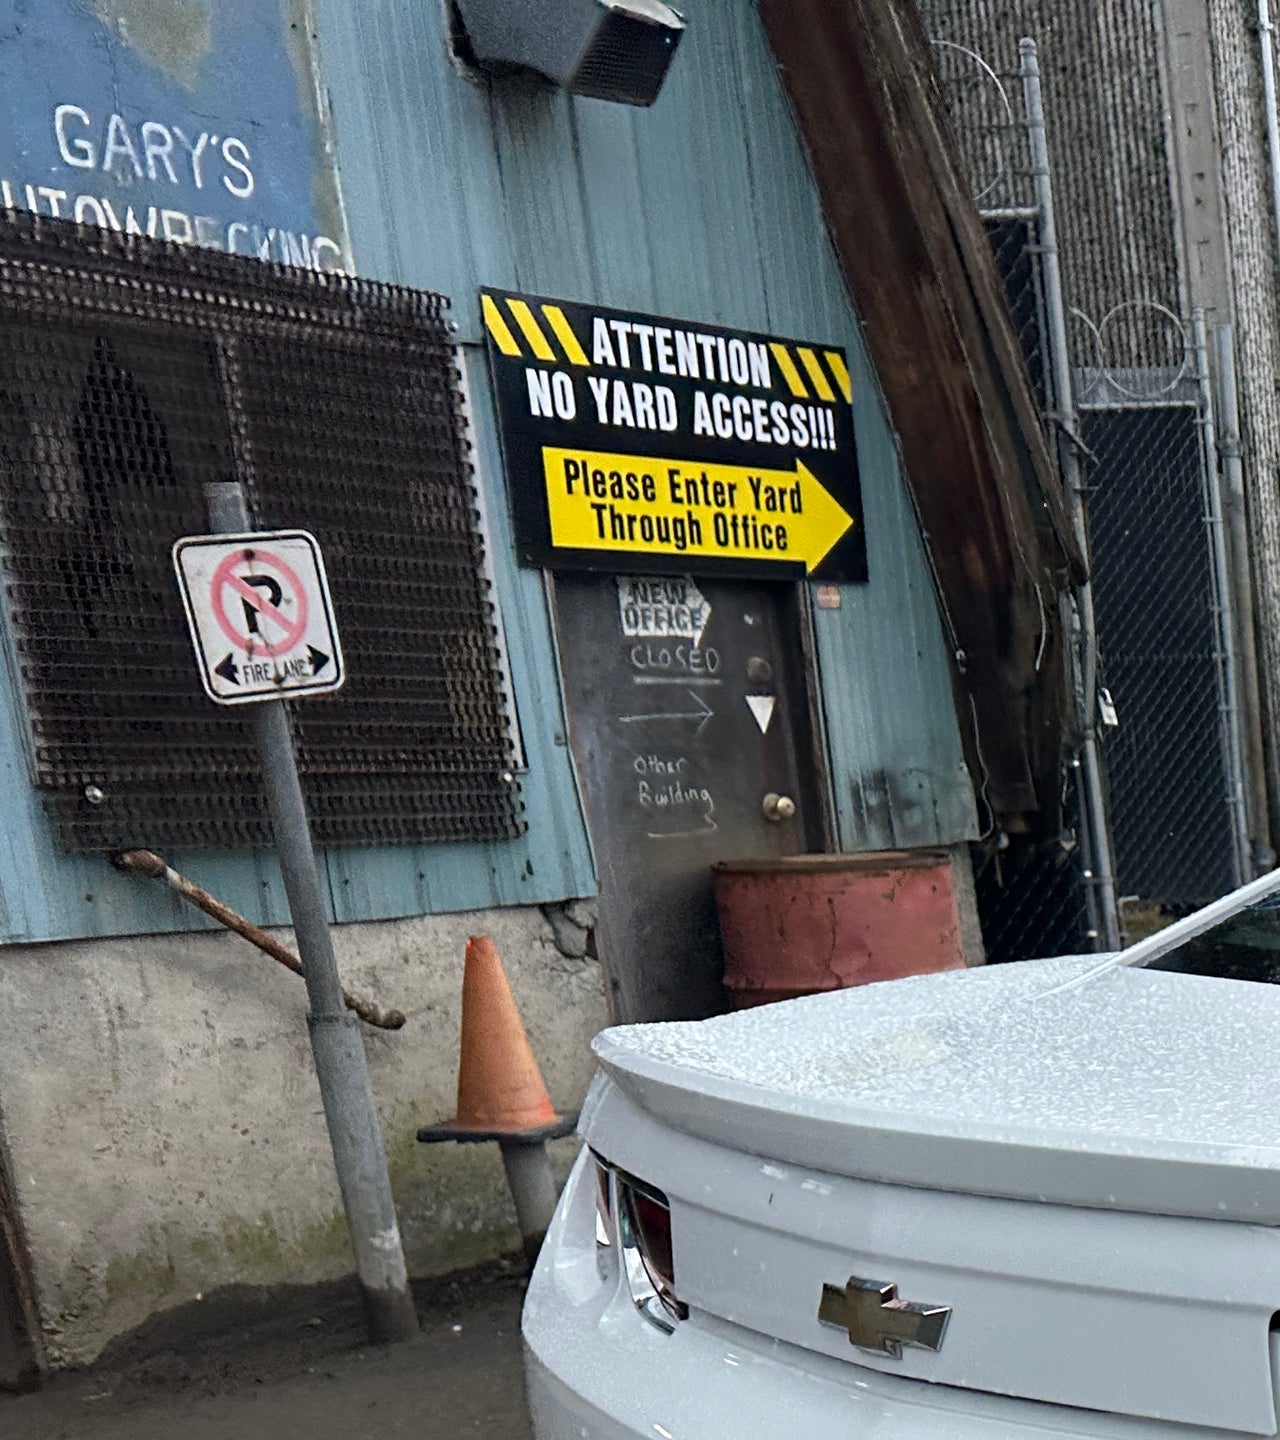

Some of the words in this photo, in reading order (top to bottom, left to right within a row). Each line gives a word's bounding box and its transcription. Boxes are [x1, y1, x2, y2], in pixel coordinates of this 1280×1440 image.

[55, 103, 254, 199] GARY'S
[592, 317, 773, 389] ATTENTION
[525, 368, 576, 421] NO
[588, 377, 678, 432] YARD
[693, 391, 837, 450] ACCESS!!!
[563, 459, 656, 501] Please
[668, 469, 737, 509] Enter
[747, 477, 803, 515] Yard
[591, 503, 705, 550] Through
[714, 513, 788, 551] Office
[629, 582, 687, 604] NEW
[624, 602, 702, 633] OFFICE
[243, 662, 272, 684] FIRE
[631, 644, 720, 673] CLOSED
[633, 755, 688, 774] Other
[638, 780, 714, 815] Building
